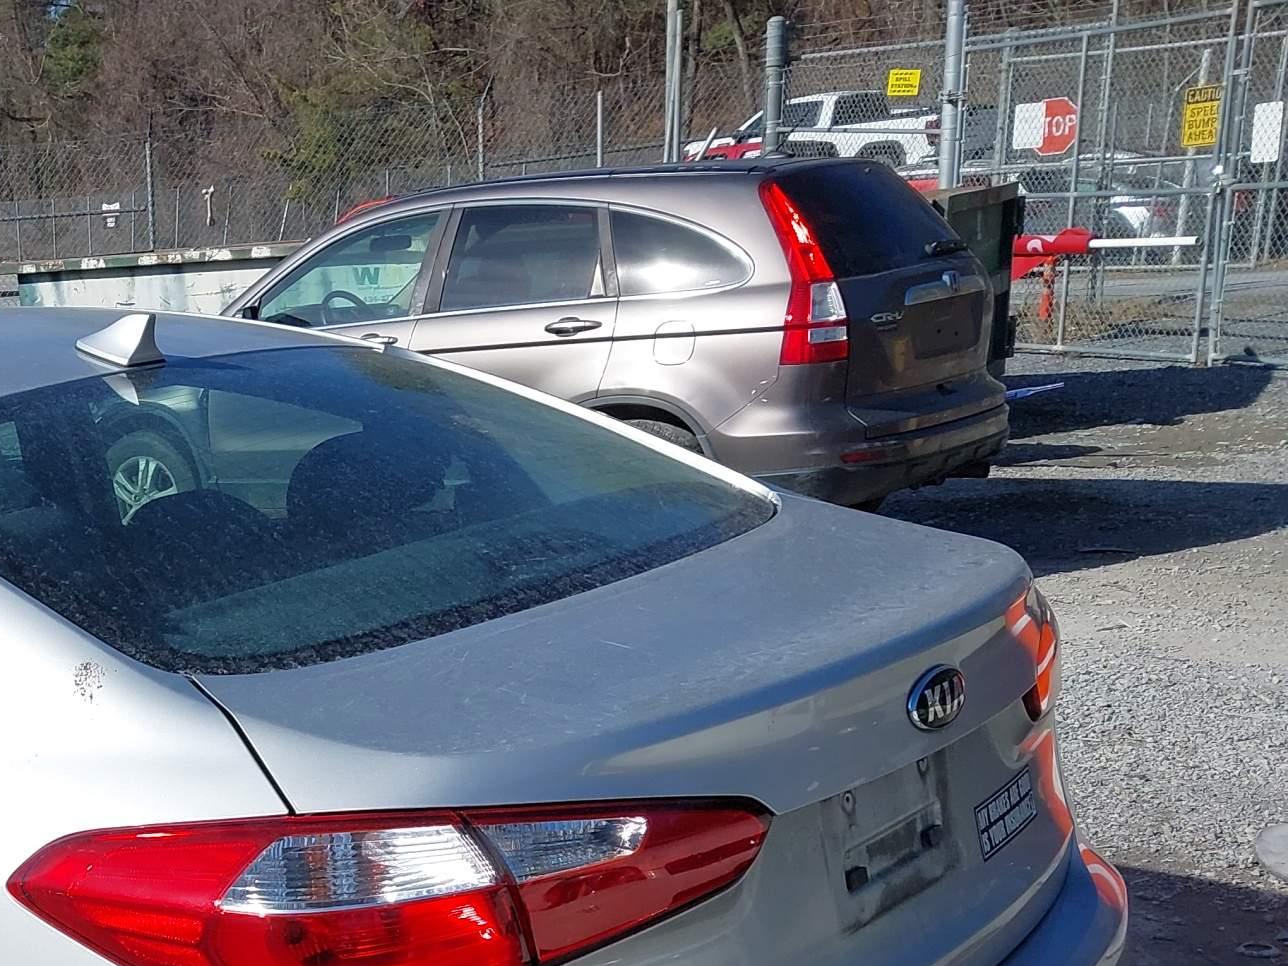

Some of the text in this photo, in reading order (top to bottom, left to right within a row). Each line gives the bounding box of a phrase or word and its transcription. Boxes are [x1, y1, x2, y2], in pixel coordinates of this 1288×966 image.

[1188, 87, 1223, 103] CAUTIO
[1190, 104, 1218, 118] SPEE
[1043, 114, 1077, 138] TOP
[1186, 129, 1215, 142] AHEA
[923, 673, 965, 724] KIA
